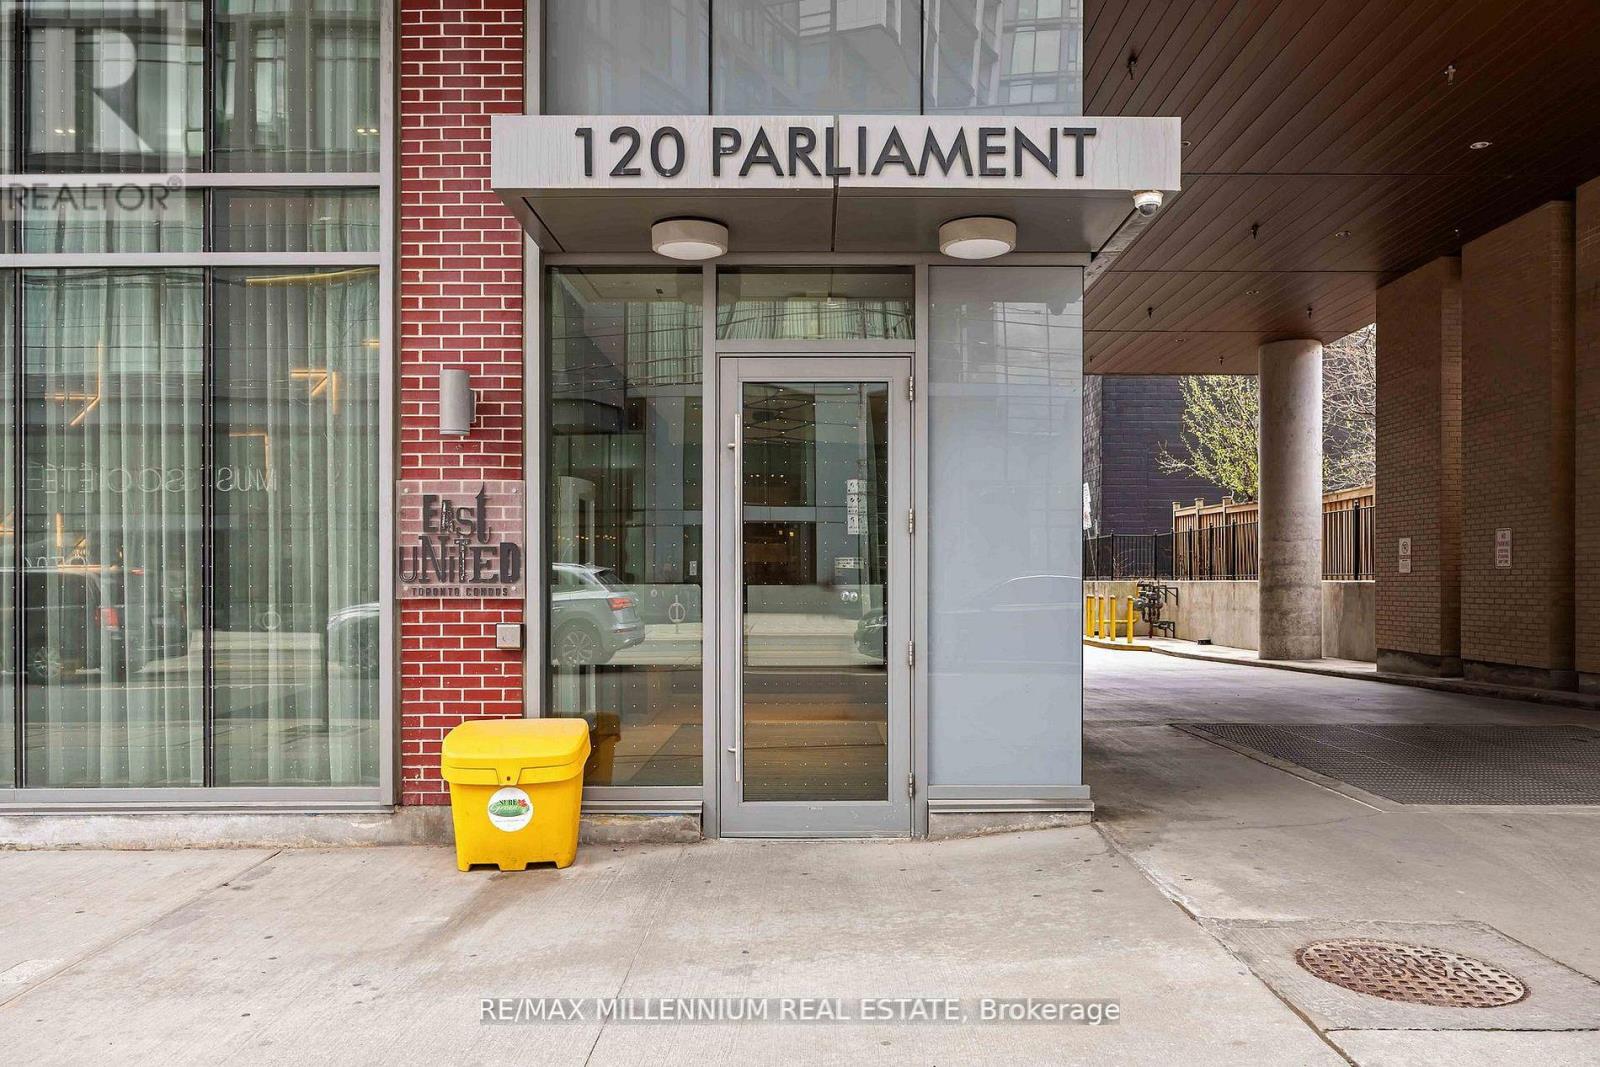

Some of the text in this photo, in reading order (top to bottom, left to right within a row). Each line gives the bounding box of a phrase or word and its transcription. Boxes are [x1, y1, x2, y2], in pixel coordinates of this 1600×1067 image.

[575, 125, 1097, 177] 120 PARLIAMENT
[412, 588, 508, 597] TORONTO CONDOS
